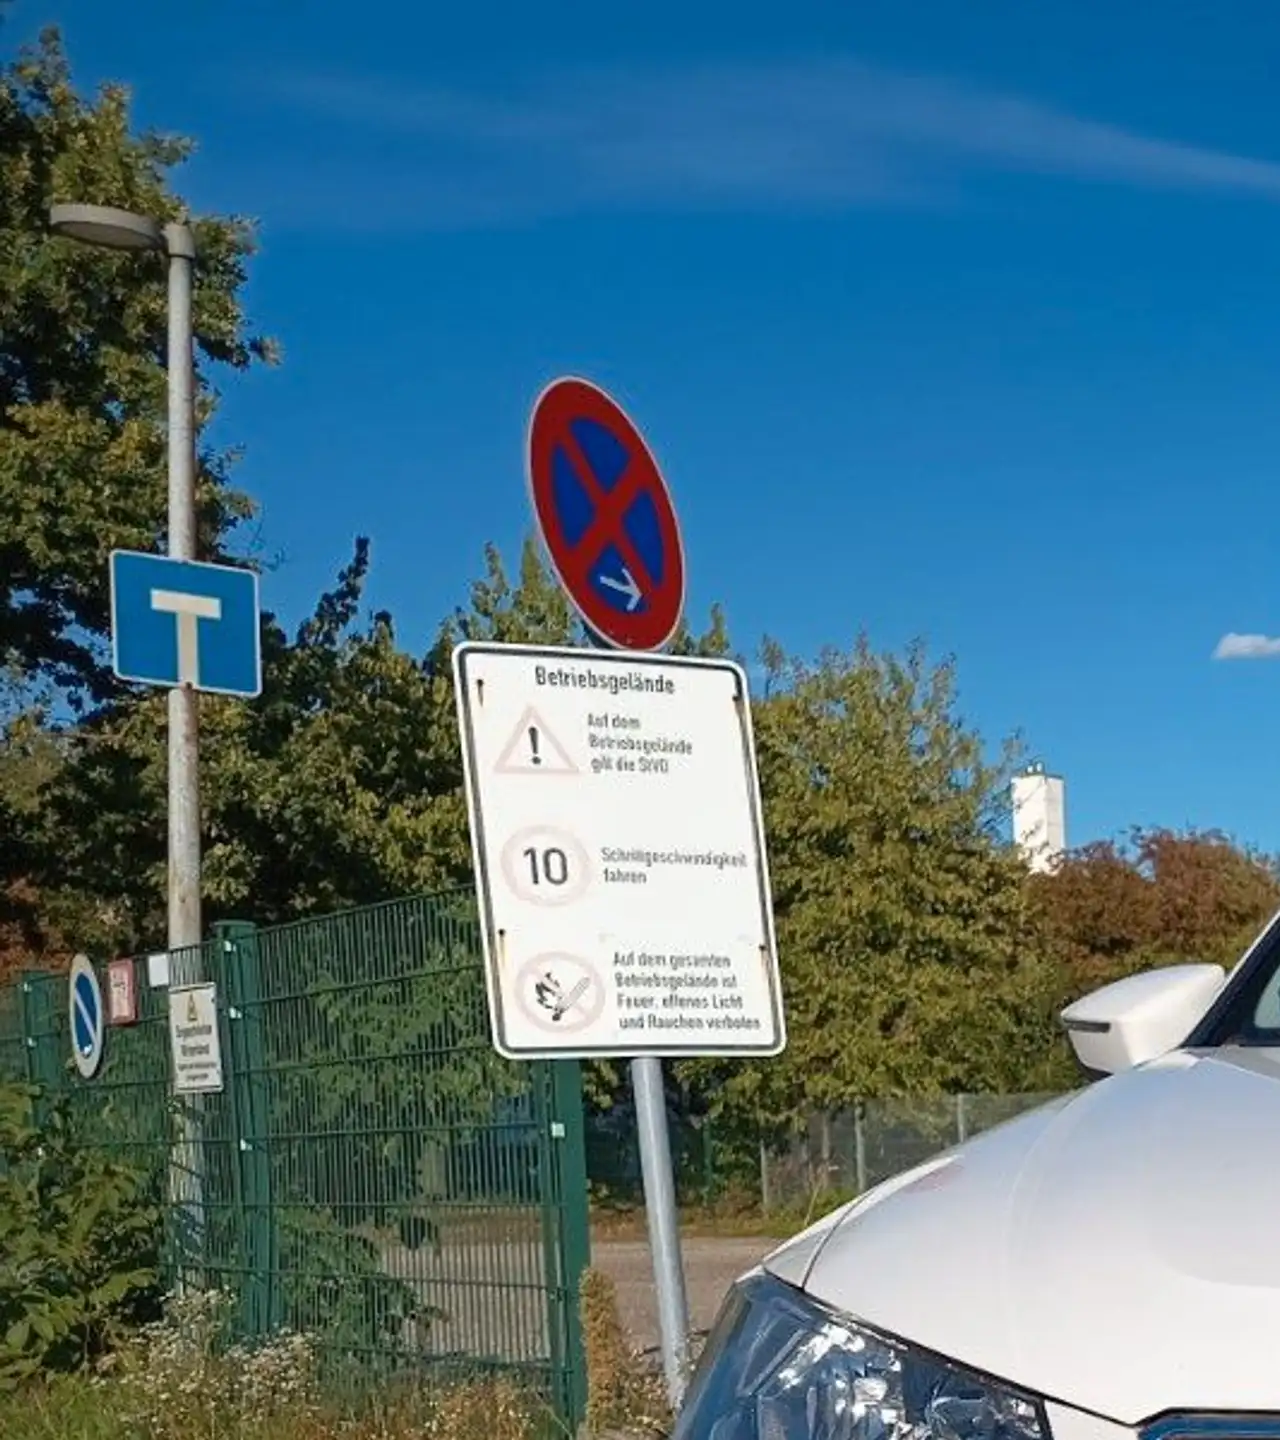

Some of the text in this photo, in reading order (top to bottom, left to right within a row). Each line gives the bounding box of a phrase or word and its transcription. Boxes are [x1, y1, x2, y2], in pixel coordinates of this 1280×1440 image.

[535, 666, 675, 695] Betriebsgelände
[588, 732, 693, 755] Betriebsgelände
[523, 847, 569, 885] 10
[604, 868, 647, 884] fahren
[613, 951, 634, 966] Auf
[637, 952, 666, 967] dem
[619, 1012, 761, 1029] und Rauchen verboten
